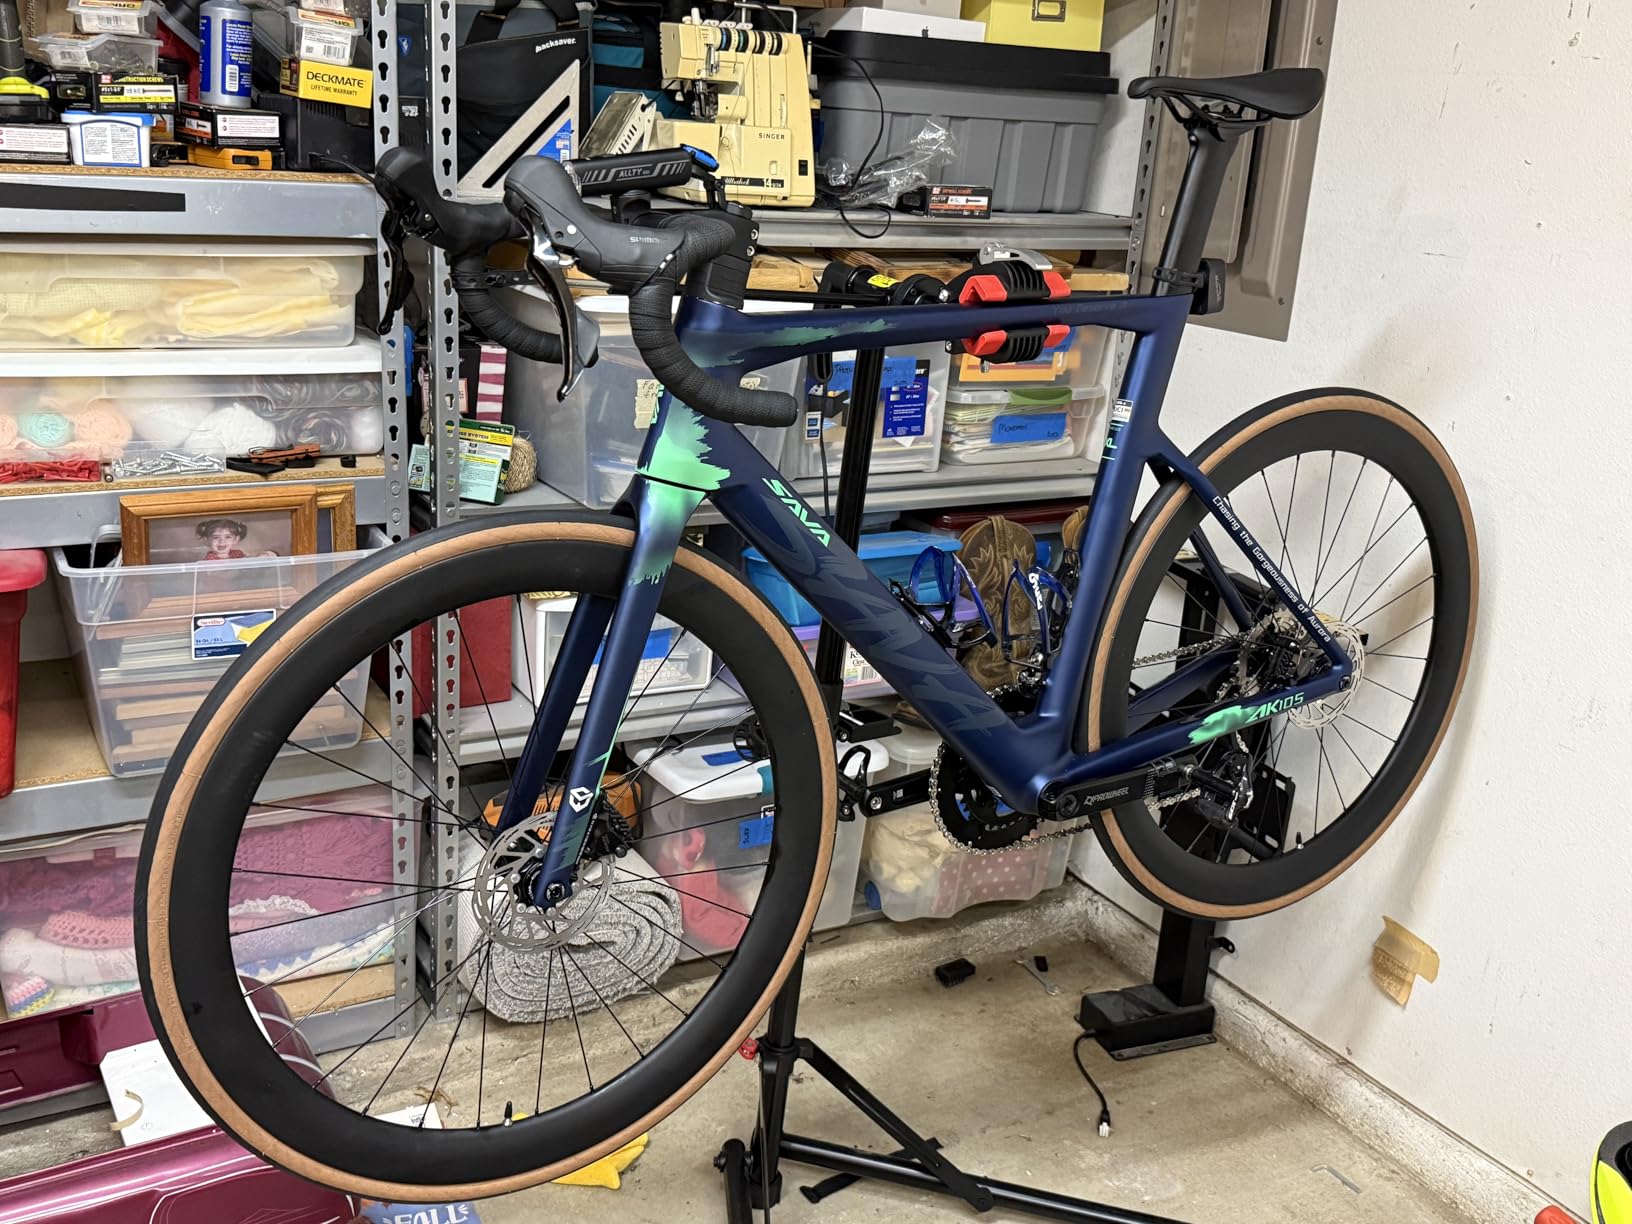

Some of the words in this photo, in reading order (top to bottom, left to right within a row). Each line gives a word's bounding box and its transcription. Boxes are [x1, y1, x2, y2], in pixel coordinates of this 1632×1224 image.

[306, 71, 364, 88] DECKMATE
[310, 84, 332, 93] LIFETIME
[333, 87, 358, 96] WARRANTY
[758, 132, 785, 140] SINGER
[618, 168, 643, 178] ALLTY
[761, 477, 831, 548] SAVA
[1212, 495, 1241, 531] Chasing
[1239, 530, 1253, 546] the
[1252, 546, 1299, 603] Gorgeousness
[1297, 603, 1310, 614] of
[1306, 615, 1332, 643] Aurora
